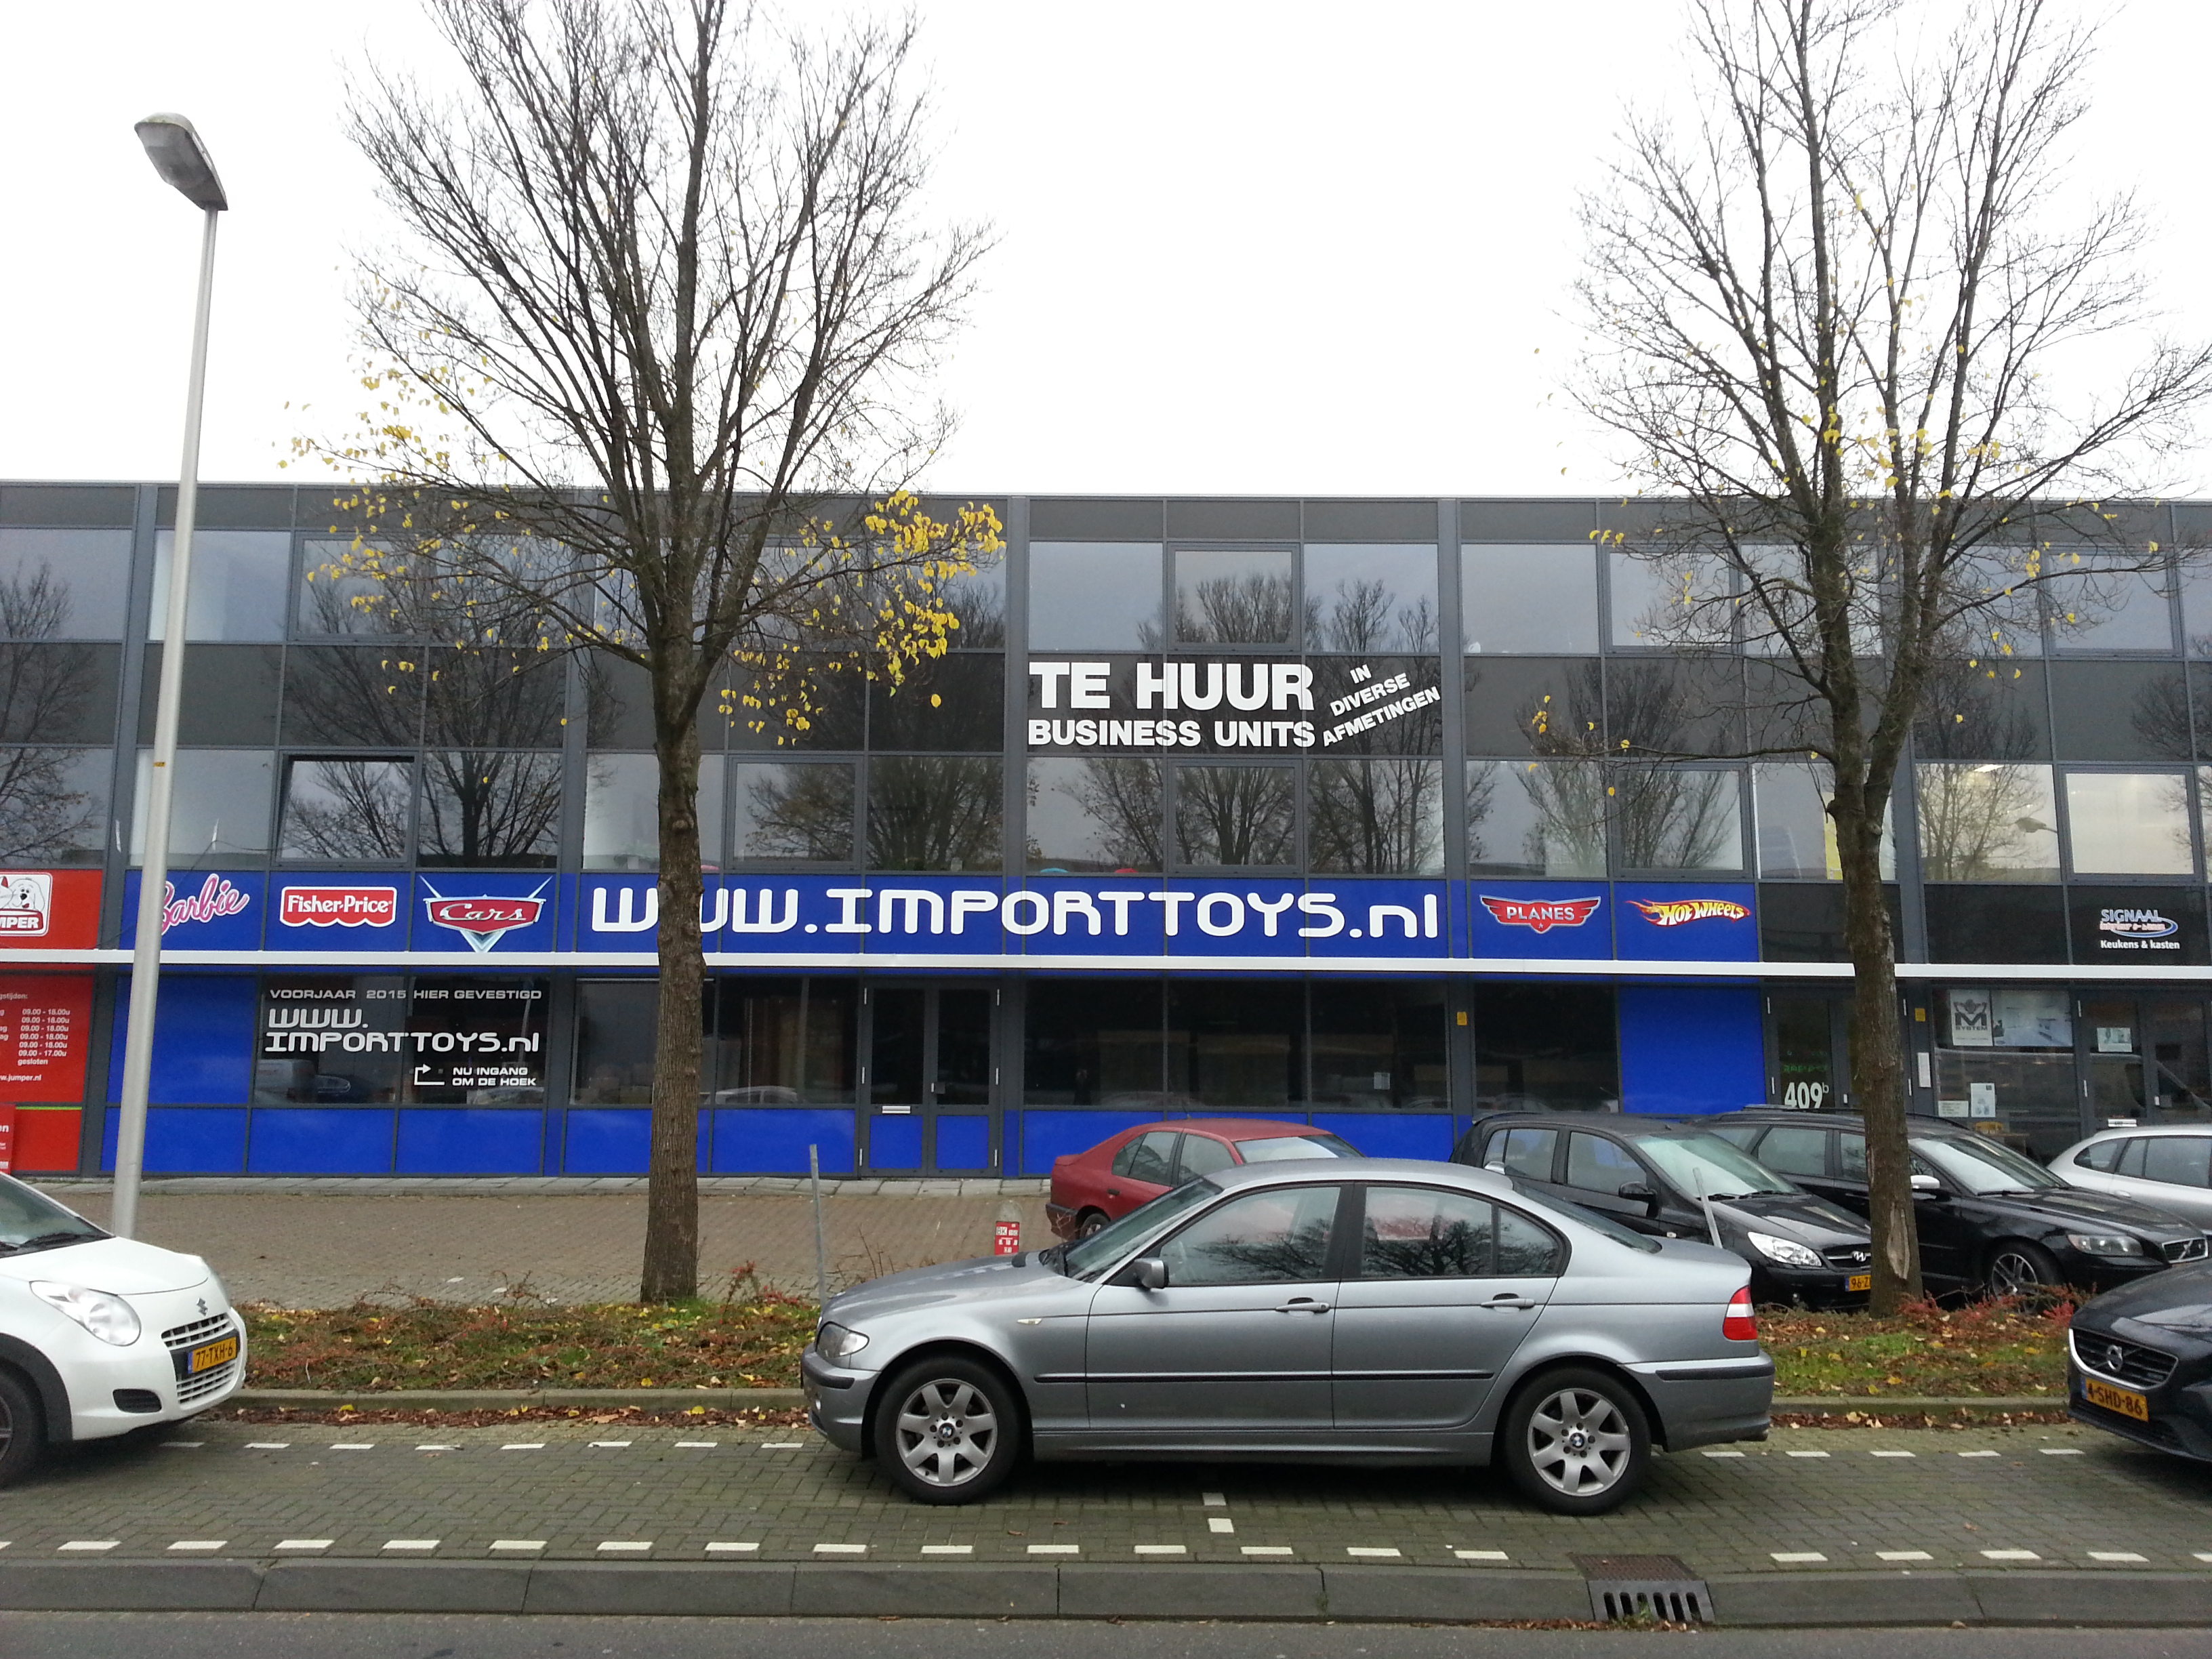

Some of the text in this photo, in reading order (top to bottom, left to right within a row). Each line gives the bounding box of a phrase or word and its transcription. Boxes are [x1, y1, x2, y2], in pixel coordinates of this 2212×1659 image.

[1349, 664, 1372, 684] IN
[1029, 662, 1313, 711] TE HUUR
[1330, 673, 1410, 716] DIVERSE
[1323, 686, 1441, 747] AFMETINGEN
[1028, 720, 1315, 747] BUSINESS UNITS
[287, 895, 389, 913] Fisher-Price
[440, 903, 527, 921] Cars
[1507, 906, 1575, 921] PLANES
[2101, 909, 2162, 922] SIGNAAL
[2100, 939, 2180, 949] Keukens & kasten
[270, 989, 542, 999] VOORJAAR 2015 HIER GEVESTIGD
[268, 1008, 369, 1028] WWW.
[265, 1032, 539, 1052] IMPORTTOYS.nl
[453, 1067, 529, 1076] NU INGANG
[452, 1078, 537, 1086] OM DE HOEK
[1851, 1277, 1871, 1288] 96-Z
[196, 1341, 233, 1368] 77-TXH-6
[2088, 1382, 2142, 1416] 4-SHD-86
